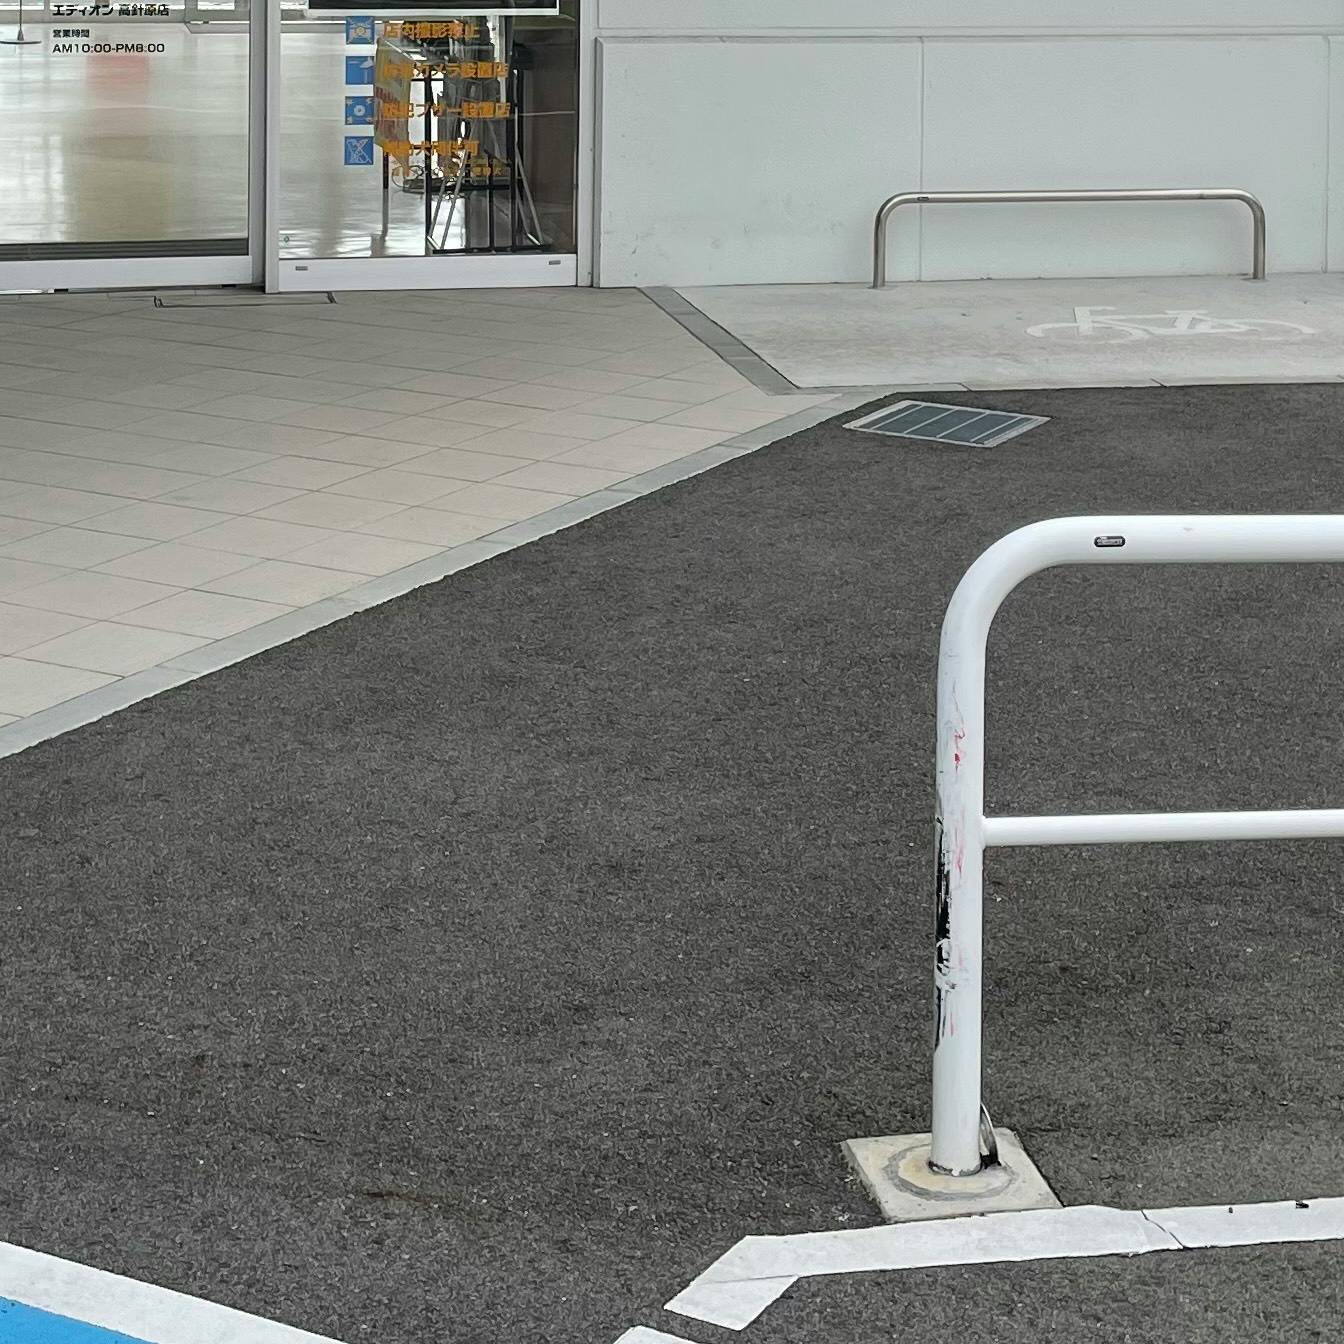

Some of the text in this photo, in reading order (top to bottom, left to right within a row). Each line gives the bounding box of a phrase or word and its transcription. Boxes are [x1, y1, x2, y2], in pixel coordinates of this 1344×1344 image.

[52, 4, 169, 17] エディオン 高針原店
[52, 29, 90, 39] 営業時間
[52, 43, 166, 54] AM10:00-PM8:00
